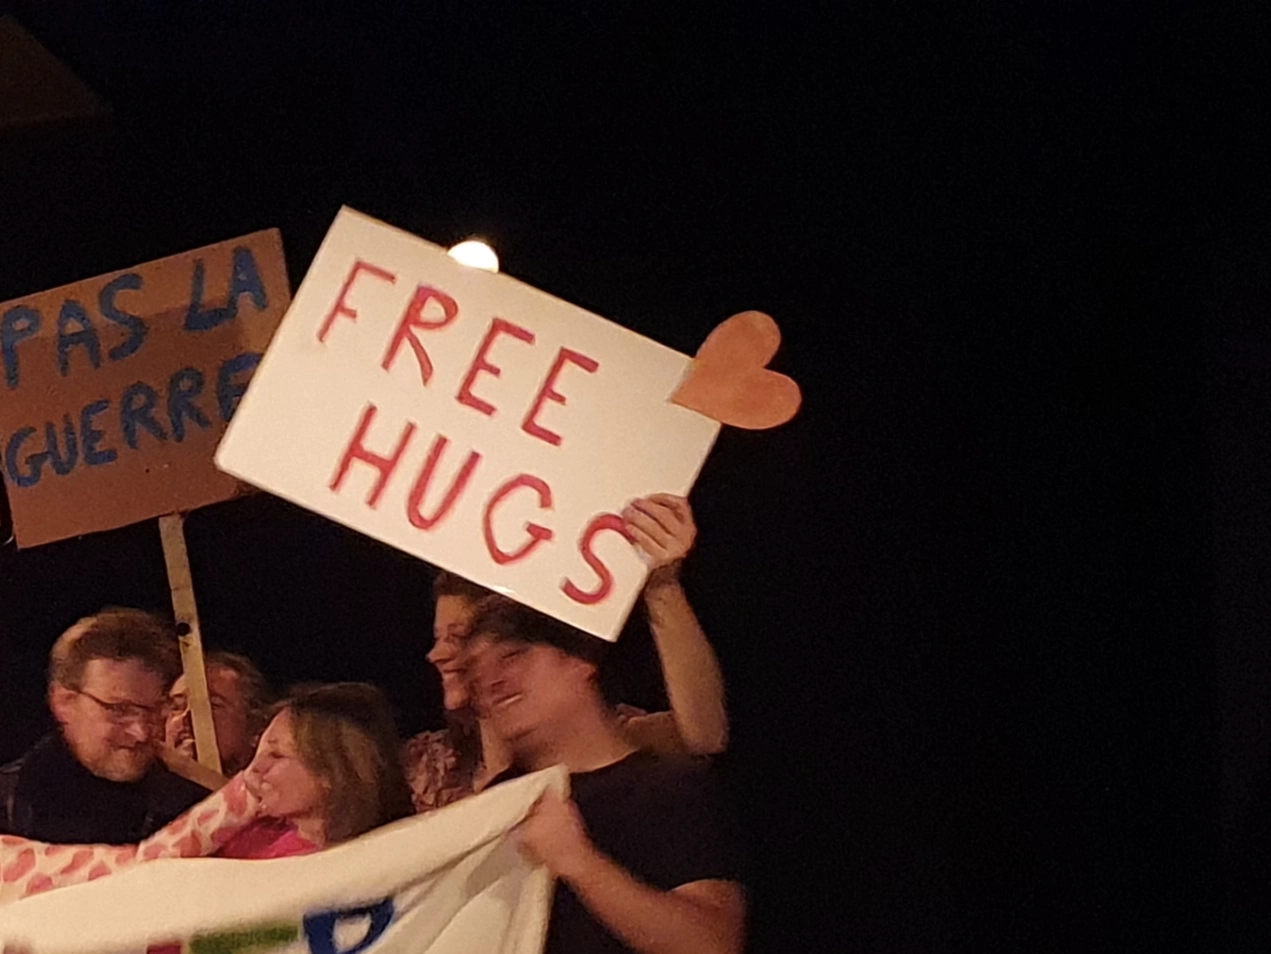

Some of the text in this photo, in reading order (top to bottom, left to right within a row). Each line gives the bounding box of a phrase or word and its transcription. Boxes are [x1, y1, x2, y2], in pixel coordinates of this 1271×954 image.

[0, 246, 269, 389] PAS LA
[318, 259, 599, 446] FREE
[329, 401, 636, 605] HUGS
